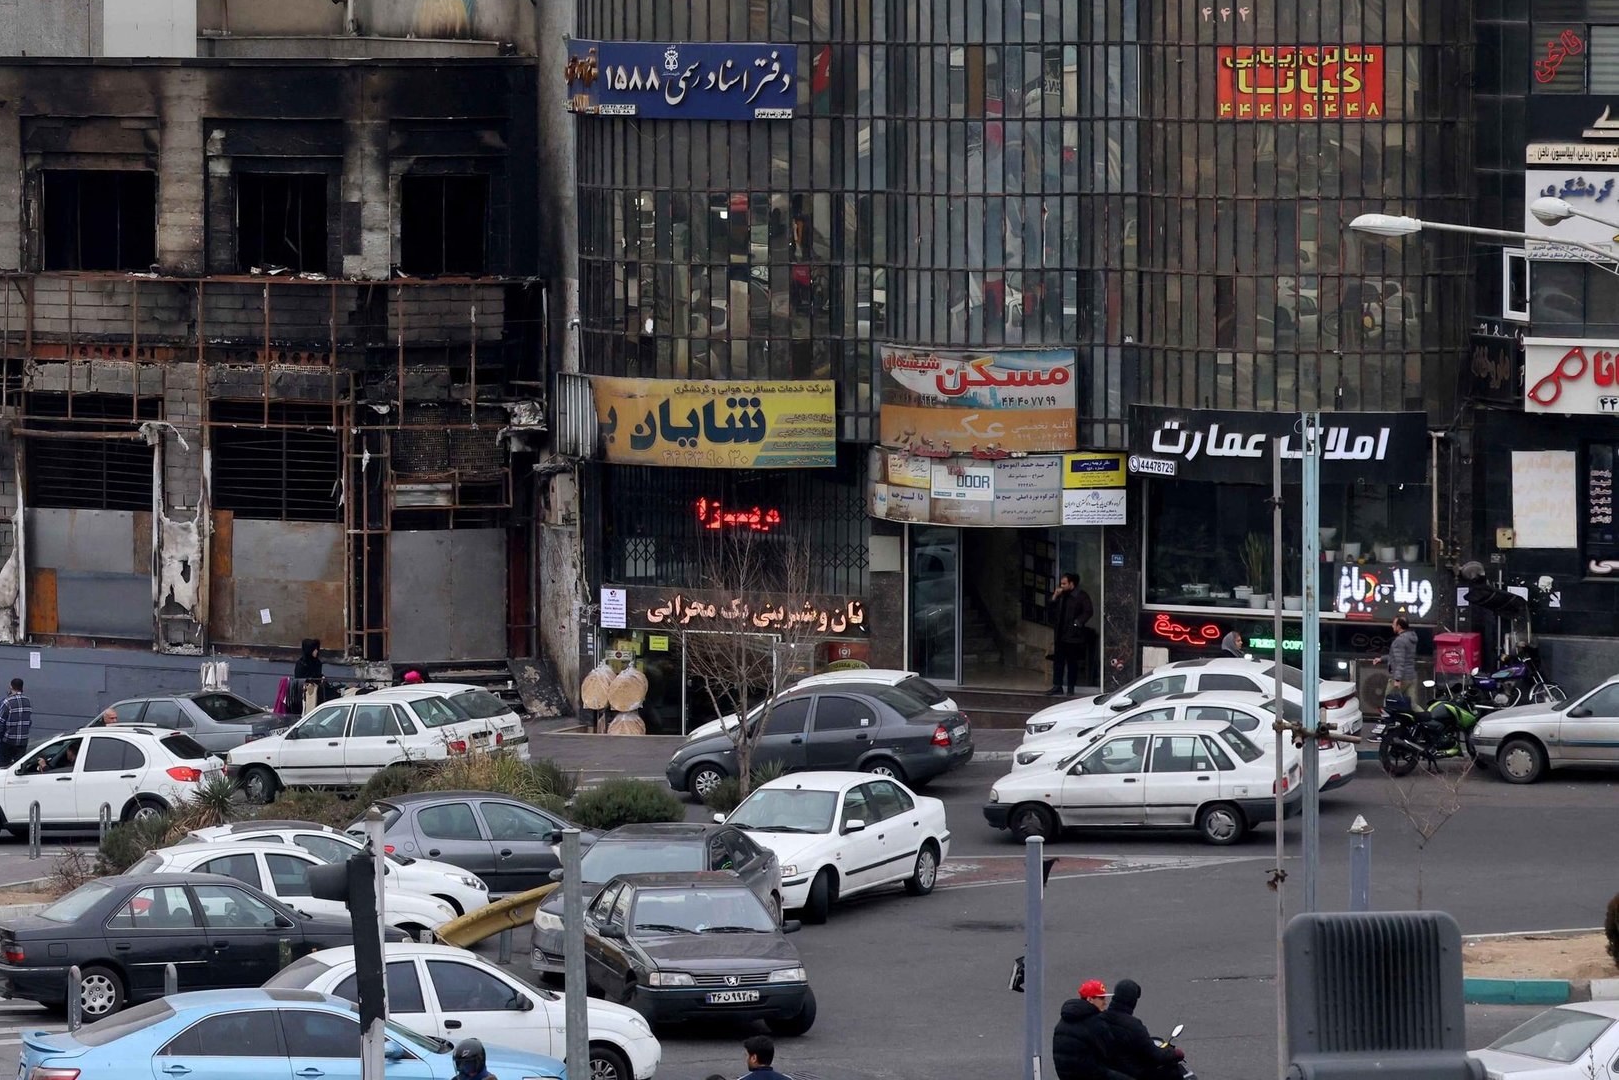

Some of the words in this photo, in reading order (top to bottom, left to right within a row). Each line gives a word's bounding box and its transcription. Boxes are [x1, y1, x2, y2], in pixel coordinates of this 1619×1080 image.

[1225, 49, 1303, 68] زیبایی
[606, 65, 660, 91] ۱۵۸۸
[665, 60, 700, 105] رسمی
[745, 50, 790, 104] دفتر
[1238, 66, 1361, 101] کیانا
[674, 384, 710, 395] گردشگری
[718, 385, 741, 395] هوایی
[778, 384, 804, 393] خدمات
[806, 383, 831, 395] شرکت
[936, 356, 1070, 397] مسکن
[630, 397, 767, 451] شایان
[1152, 421, 1266, 461] عمارت
[956, 475, 990, 488] DOOR
[1140, 461, 1174, 474] 44478729
[1393, 568, 1433, 617] ویلا
[647, 594, 716, 624] محرابی
[753, 601, 817, 629] شیرینی
[817, 611, 828, 632] و
[831, 601, 864, 632] نان
